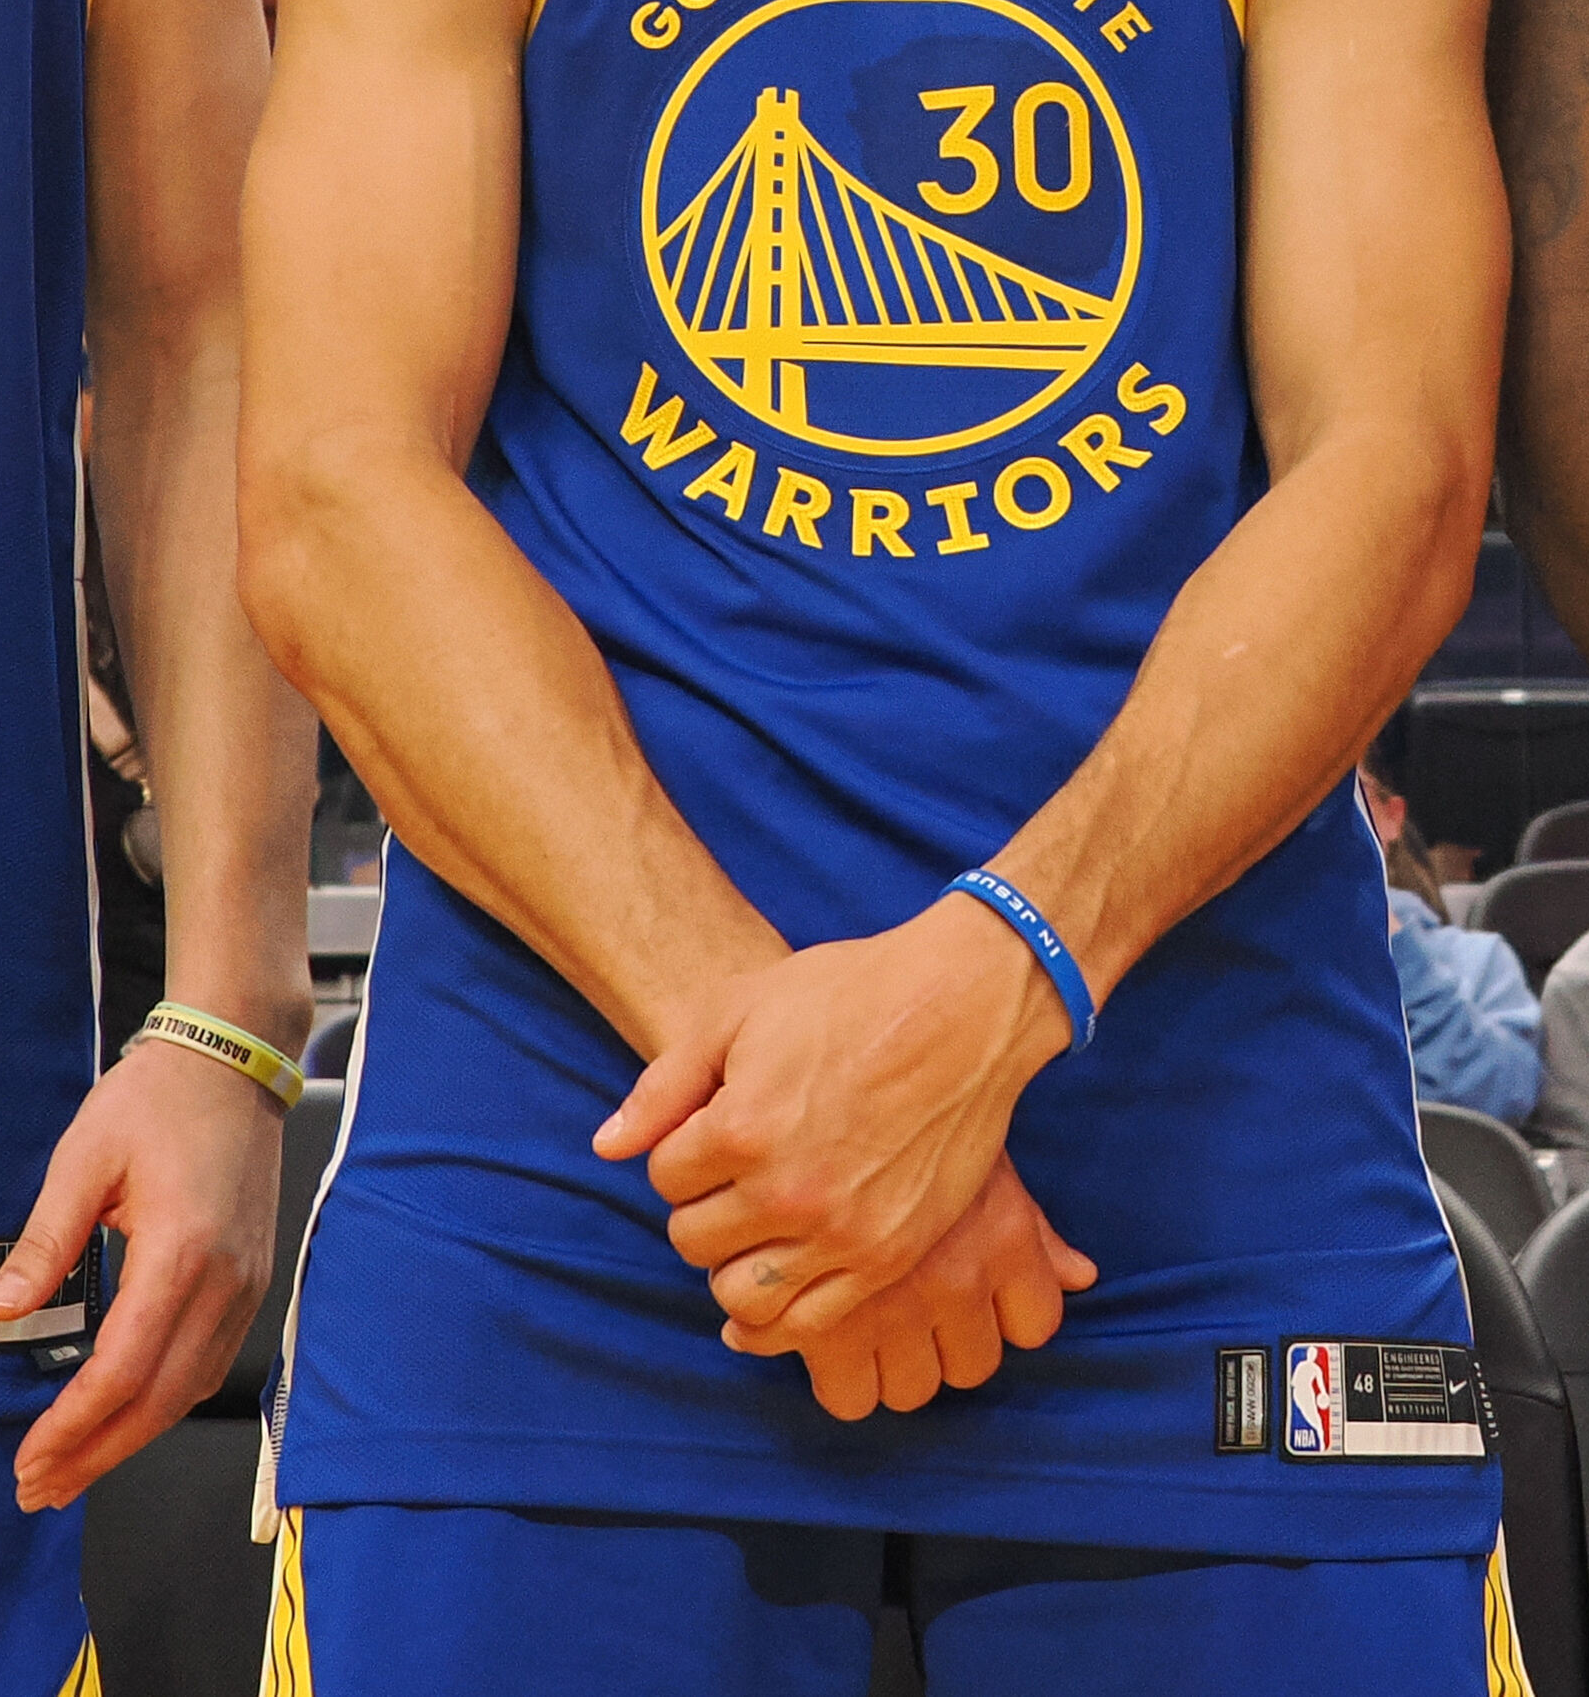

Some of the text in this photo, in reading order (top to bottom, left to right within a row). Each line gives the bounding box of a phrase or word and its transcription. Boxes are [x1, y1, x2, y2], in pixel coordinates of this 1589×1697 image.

[917, 80, 1093, 216] 30
[619, 361, 1189, 559] WARRIORS
[965, 872, 1061, 958] IN JESUS
[164, 1017, 253, 1065] BASKETBALL
[1353, 1372, 1374, 1394] 48
[1294, 1428, 1317, 1448] NBA
